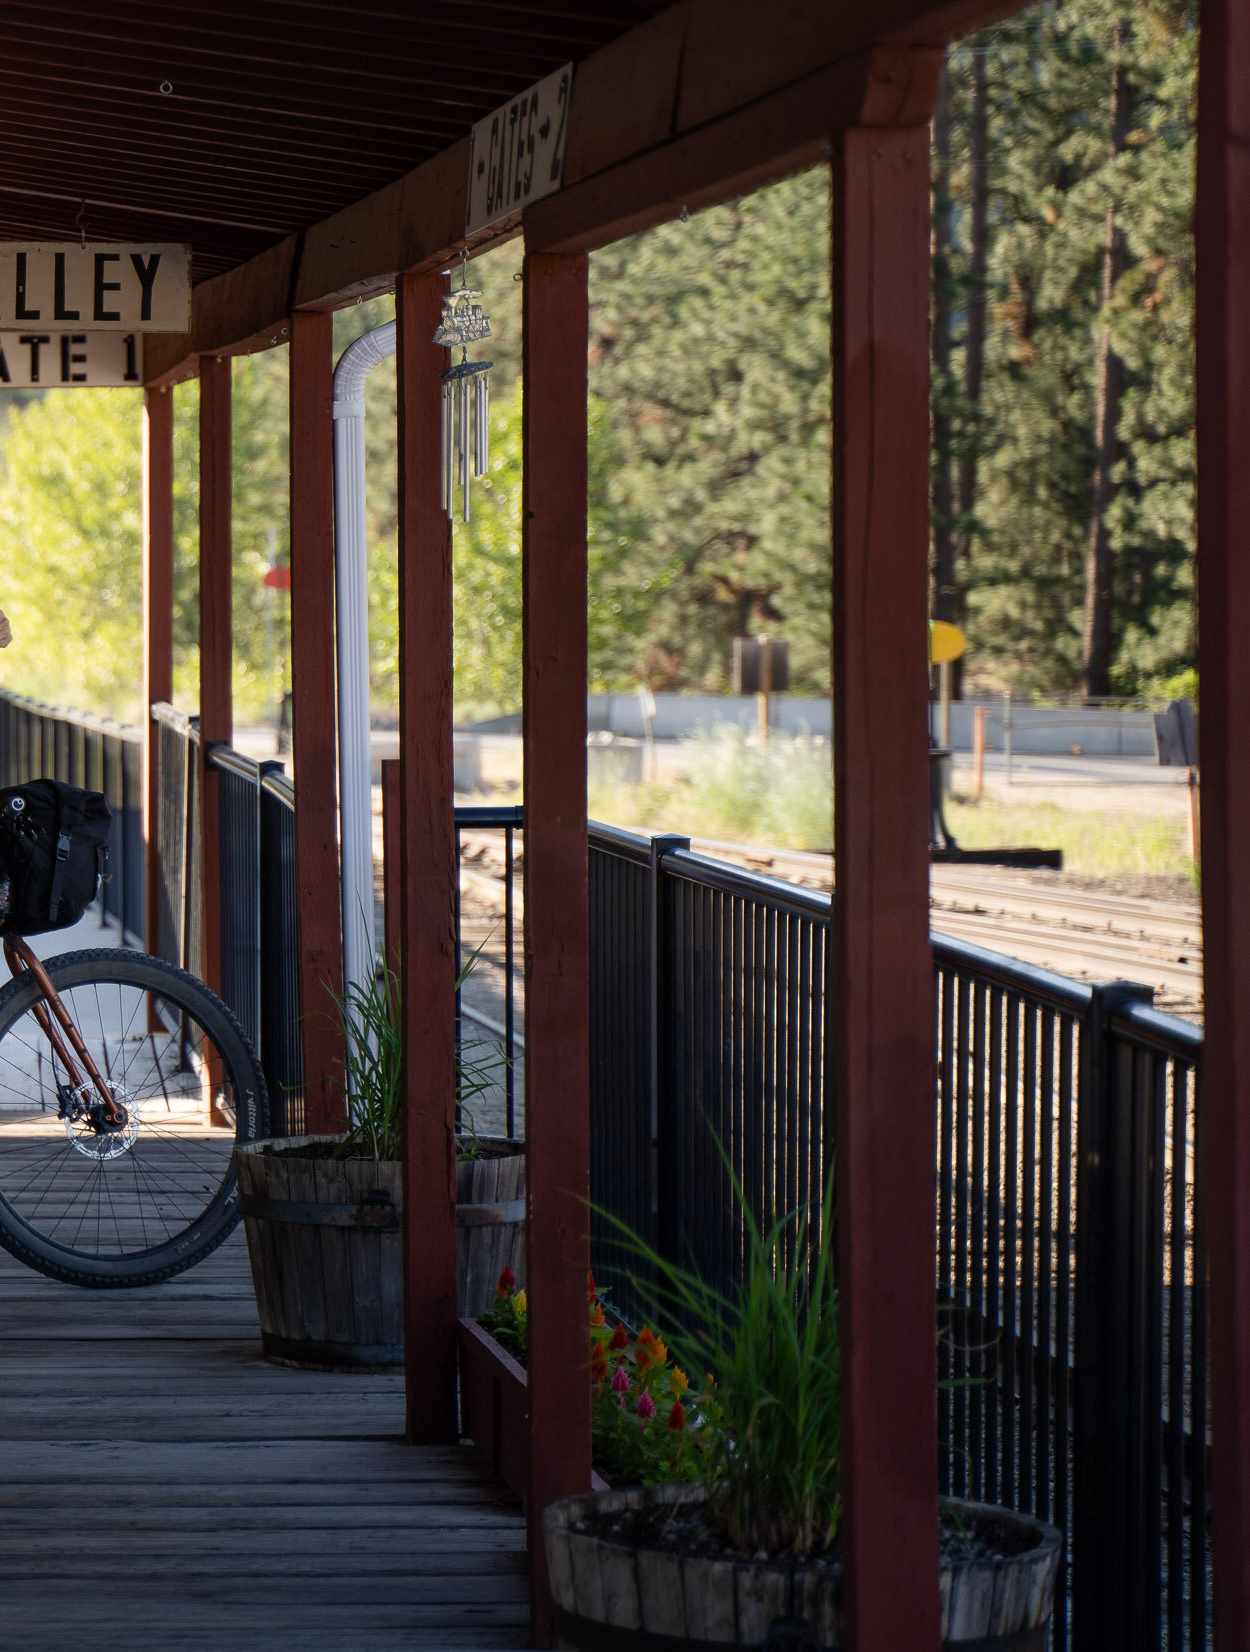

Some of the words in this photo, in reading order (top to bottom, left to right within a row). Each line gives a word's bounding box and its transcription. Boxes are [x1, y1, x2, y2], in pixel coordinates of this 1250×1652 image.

[486, 90, 539, 217] GATES
[551, 73, 569, 181] 2
[122, 333, 139, 382] 1
